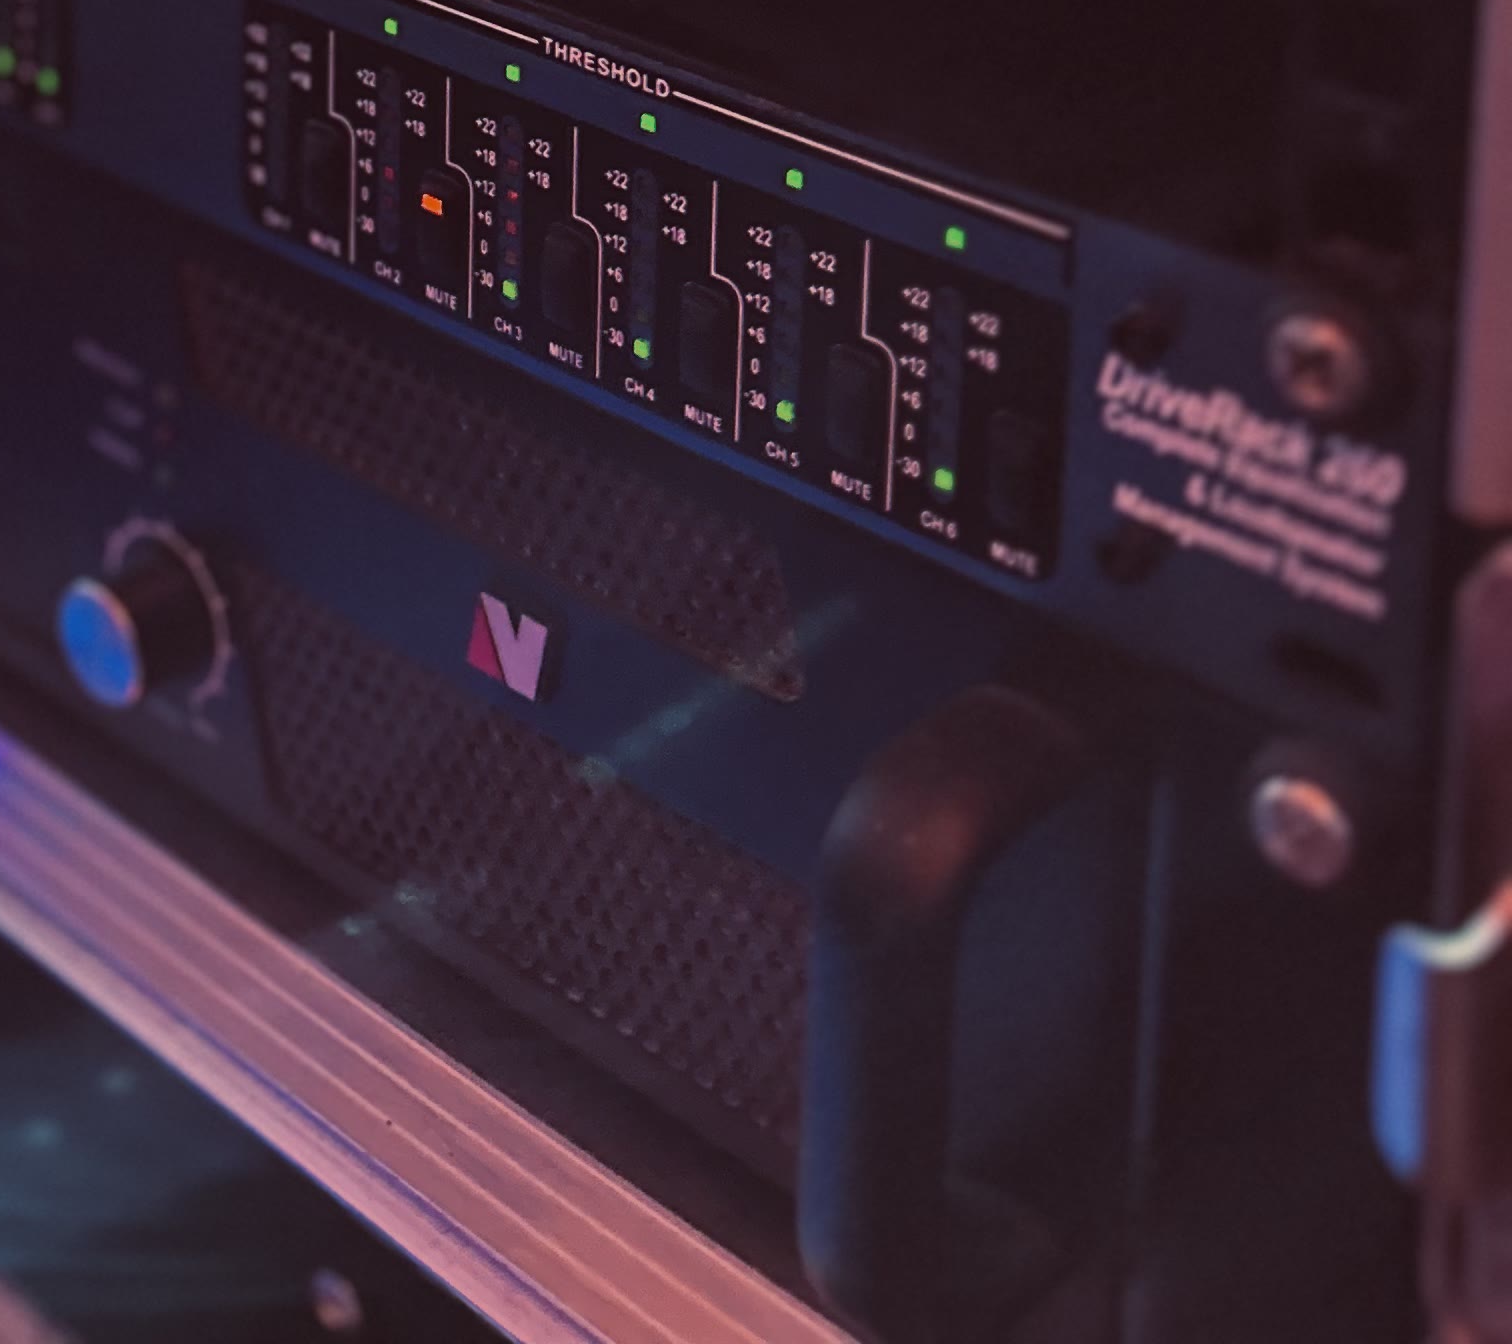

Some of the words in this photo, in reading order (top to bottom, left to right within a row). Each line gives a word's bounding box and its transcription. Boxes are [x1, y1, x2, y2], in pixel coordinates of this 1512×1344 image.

[542, 37, 670, 97] THRESHOLD
[475, 117, 496, 136] +22
[475, 147, 496, 167] +18
[528, 138, 551, 159] +22
[475, 178, 496, 198] +12
[528, 169, 550, 189] +18
[605, 169, 628, 189] +22
[604, 201, 628, 221] +18
[663, 192, 687, 213] +22
[478, 210, 492, 226] +6
[603, 233, 627, 253] +12
[662, 224, 687, 245] +18
[747, 226, 773, 248] +22
[480, 239, 488, 255] 0
[747, 261, 772, 280] +18
[809, 251, 837, 273] +22
[607, 266, 623, 283] +6
[609, 296, 618, 312] 0
[746, 294, 770, 313] +12
[809, 285, 836, 306] +18
[494, 316, 513, 336] CH
[514, 325, 523, 342] 3
[747, 326, 766, 344] +6
[549, 342, 583, 369] MUTE
[750, 358, 760, 375] 0
[625, 377, 644, 398] CH
[646, 388, 655, 401] 4
[684, 404, 722, 433] MUTE
[765, 441, 788, 462] CH
[790, 452, 800, 468] 5
[831, 470, 872, 501] MUTE
[990, 540, 1037, 576] MUTE
